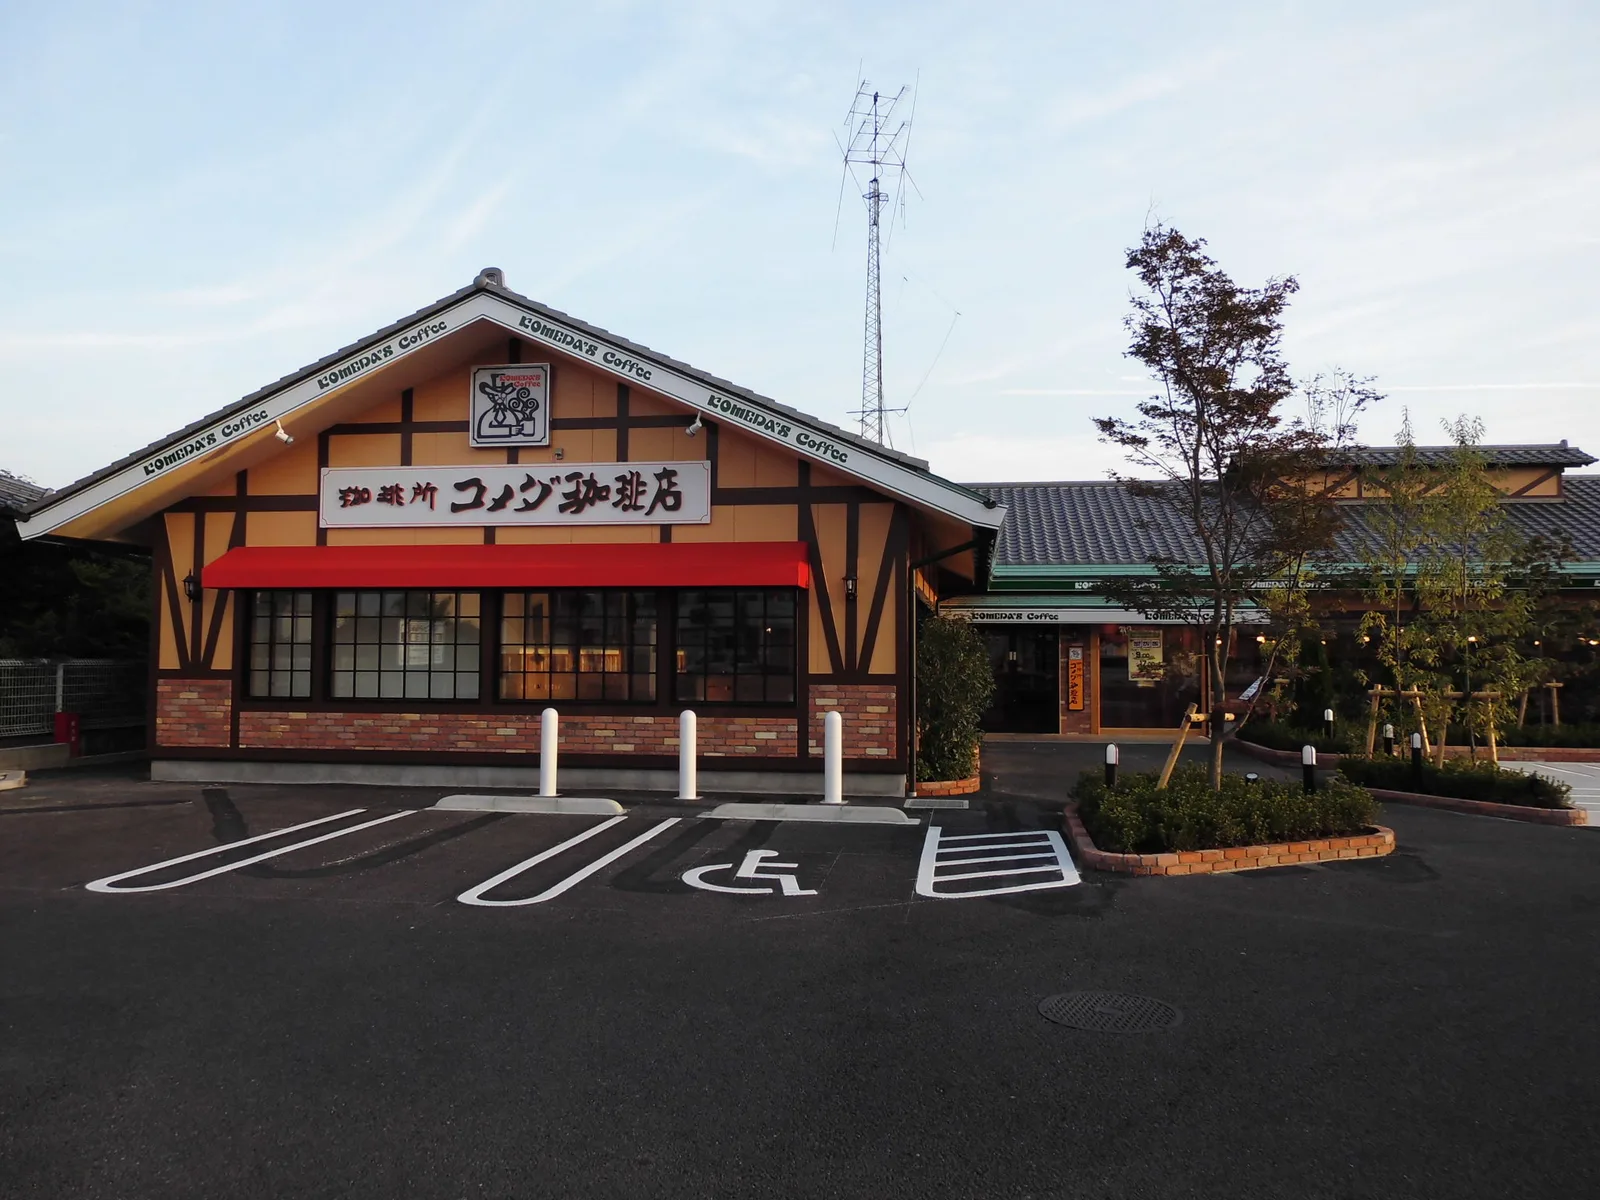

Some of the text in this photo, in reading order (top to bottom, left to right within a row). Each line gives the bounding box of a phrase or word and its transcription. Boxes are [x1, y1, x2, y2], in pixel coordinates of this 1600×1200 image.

[317, 321, 447, 390] KOMEDA'S Coffee
[519, 315, 652, 381] KOMEDA'S Coffee
[143, 410, 268, 476] KOMEDA'S Coffee
[707, 394, 848, 463] KOMEDA'S Coffee
[450, 466, 683, 516] コメダ珈琲店
[1027, 612, 1059, 621] Coffee
